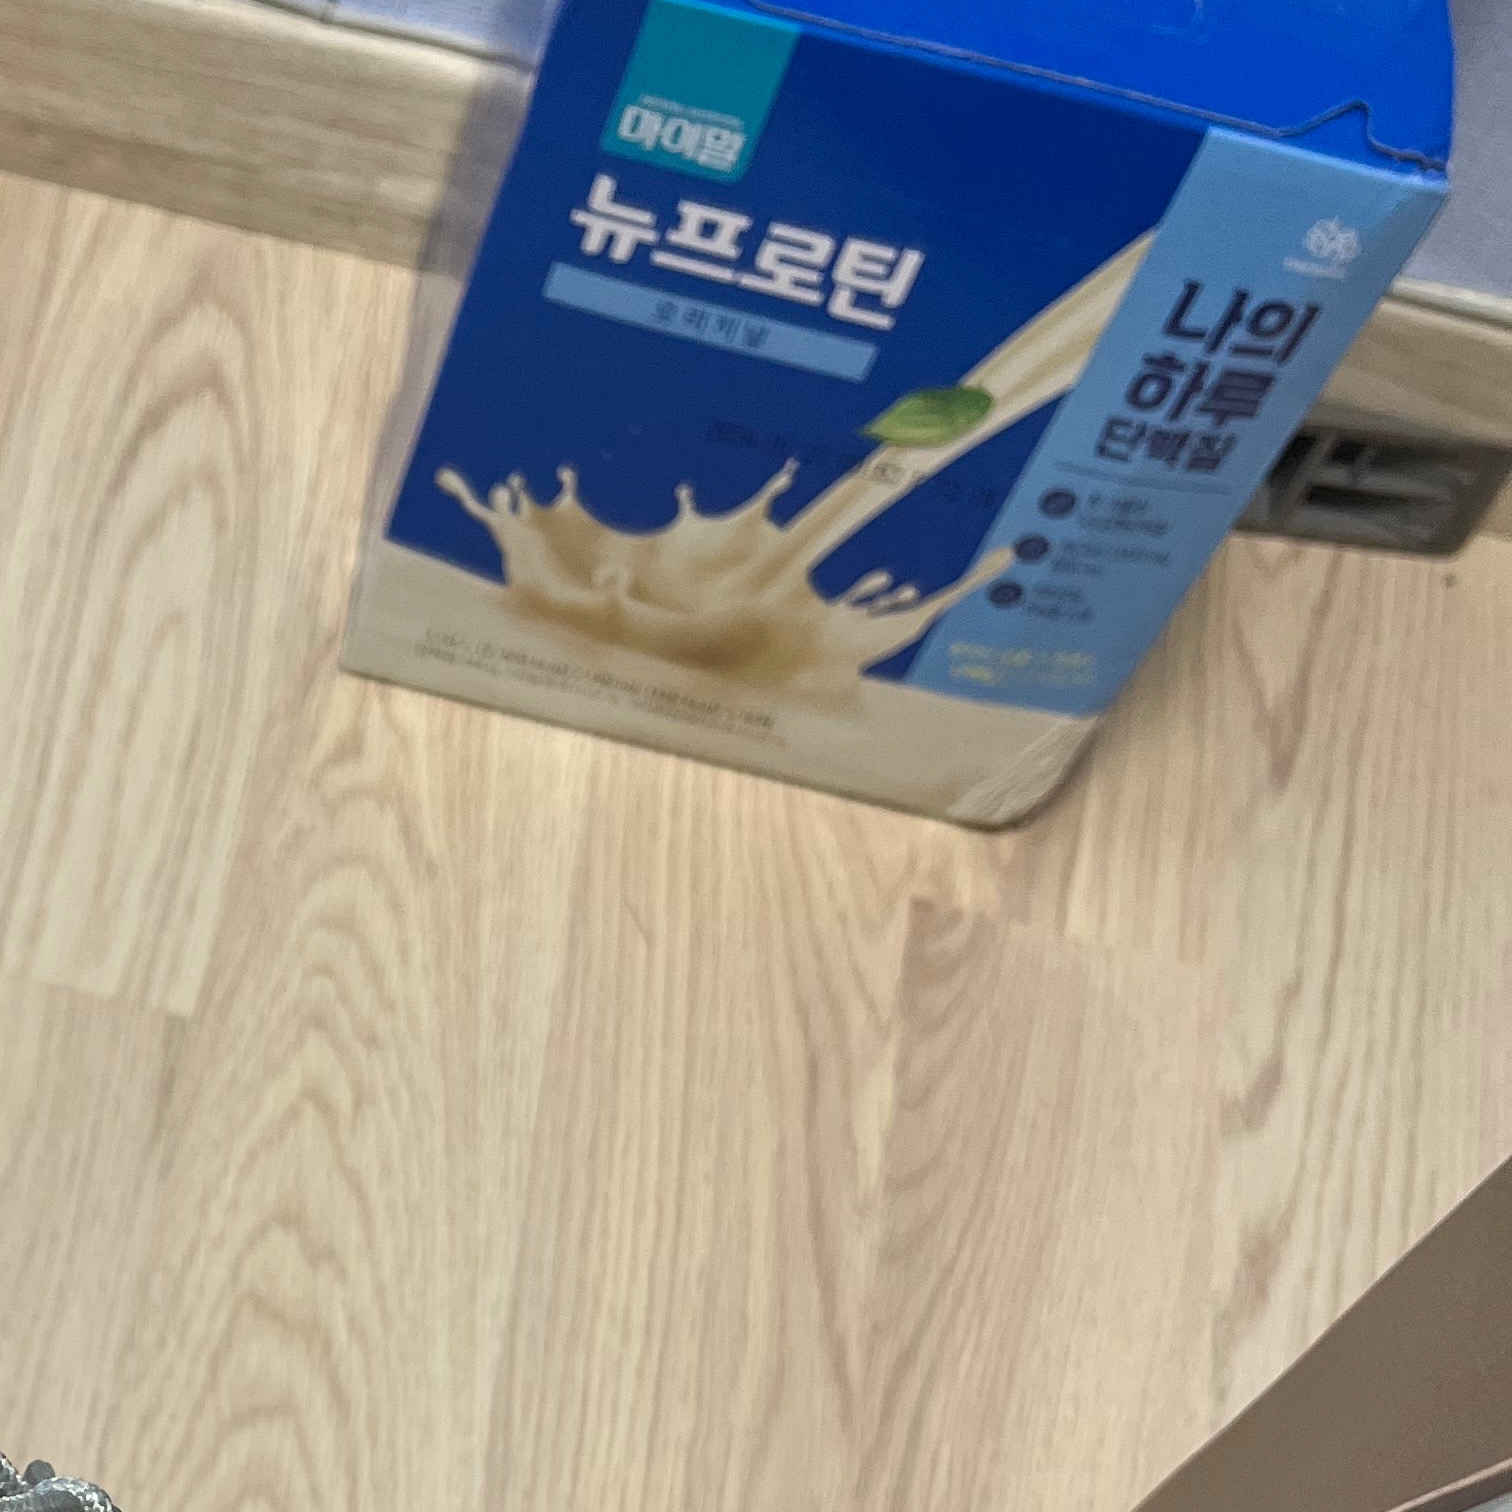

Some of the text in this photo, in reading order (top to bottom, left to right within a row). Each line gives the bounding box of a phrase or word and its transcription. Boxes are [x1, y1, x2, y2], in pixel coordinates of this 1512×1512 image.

[569, 172, 927, 332] 뉴프로틴
[1162, 278, 1323, 366] 나의
[1123, 351, 1278, 428] 하루
